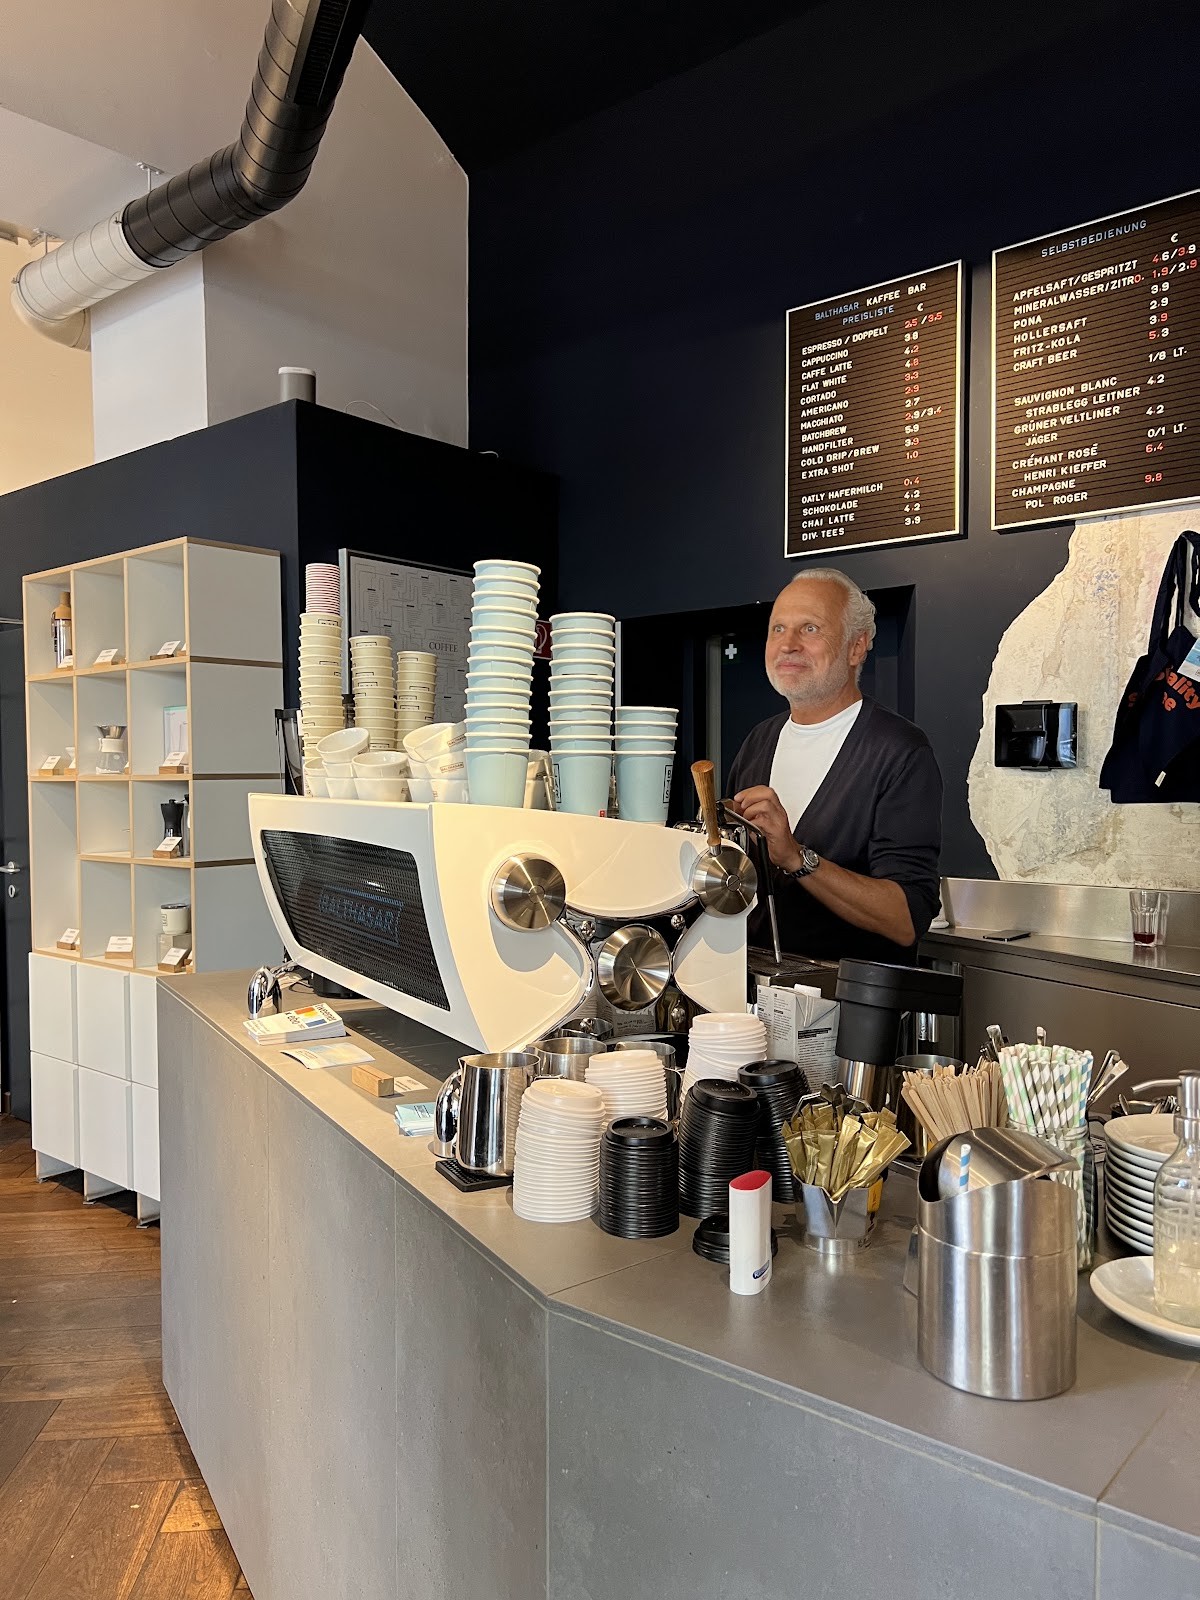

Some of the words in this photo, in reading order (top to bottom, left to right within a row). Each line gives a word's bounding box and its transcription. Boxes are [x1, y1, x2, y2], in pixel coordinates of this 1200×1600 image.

[1041, 219, 1147, 258] SELBSTBEDIENUNG
[1170, 232, 1179, 243] €
[1013, 259, 1138, 302] APFELSAFT/GESPRITZT
[815, 302, 859, 320] BALTHASAR
[866, 290, 900, 306] KAFFEE
[907, 282, 927, 295] BAR
[842, 305, 895, 325] PREISLISTE
[916, 303, 924, 312] €
[1013, 314, 1042, 330] PONA
[801, 337, 843, 355] ESPRESSO
[852, 325, 889, 343] DOPPELT
[1013, 317, 1088, 344] HOLLERSAFT
[1013, 333, 1081, 358] FRITZ-KOLA
[801, 349, 849, 368] CAPPUCCINO
[1012, 356, 1044, 372] CRAFT
[1047, 348, 1078, 364] BEER
[1148, 350, 1166, 363] 1/8
[801, 367, 826, 380] CAFFE
[829, 360, 853, 373] LATTE
[801, 381, 819, 393] FLAT
[822, 375, 847, 387] WHITE
[1014, 386, 1075, 407] SAUVIGNON
[1080, 376, 1118, 393] BLANC
[800, 390, 837, 405] CORTADO
[1025, 397, 1089, 418] STRABLEGG
[1092, 386, 1141, 405] LEITNER
[800, 400, 849, 418] AMERICANO
[1013, 418, 1058, 435] GRÜNER
[1060, 405, 1121, 426] VELTLINER
[801, 425, 847, 443] BATCHBREW
[1025, 432, 1058, 447] JÄGER
[1147, 425, 1166, 438] 0/1
[802, 437, 854, 455] HANDFILTER
[800, 455, 823, 468] COLD
[826, 444, 880, 463] DRIP/BREW
[1012, 452, 1064, 470] CRÉMANT
[1067, 443, 1098, 460] ROSÉ
[801, 467, 829, 480] EXTRA
[831, 462, 854, 475] SHOT
[1024, 467, 1057, 482] HENRI
[1060, 459, 1107, 475] KIEFFER
[801, 493, 825, 504] OATLY
[828, 482, 883, 500] HAFERMILCH
[1011, 479, 1076, 498] CHAMPAGNE
[802, 500, 858, 517] SCHOKOLADE
[1025, 498, 1045, 510] POL
[1052, 491, 1089, 506] ROGER
[801, 518, 823, 529] CHAI
[828, 513, 855, 525] LATTE
[821, 527, 845, 539] TEES
[428, 641, 459, 653] COFFEE
